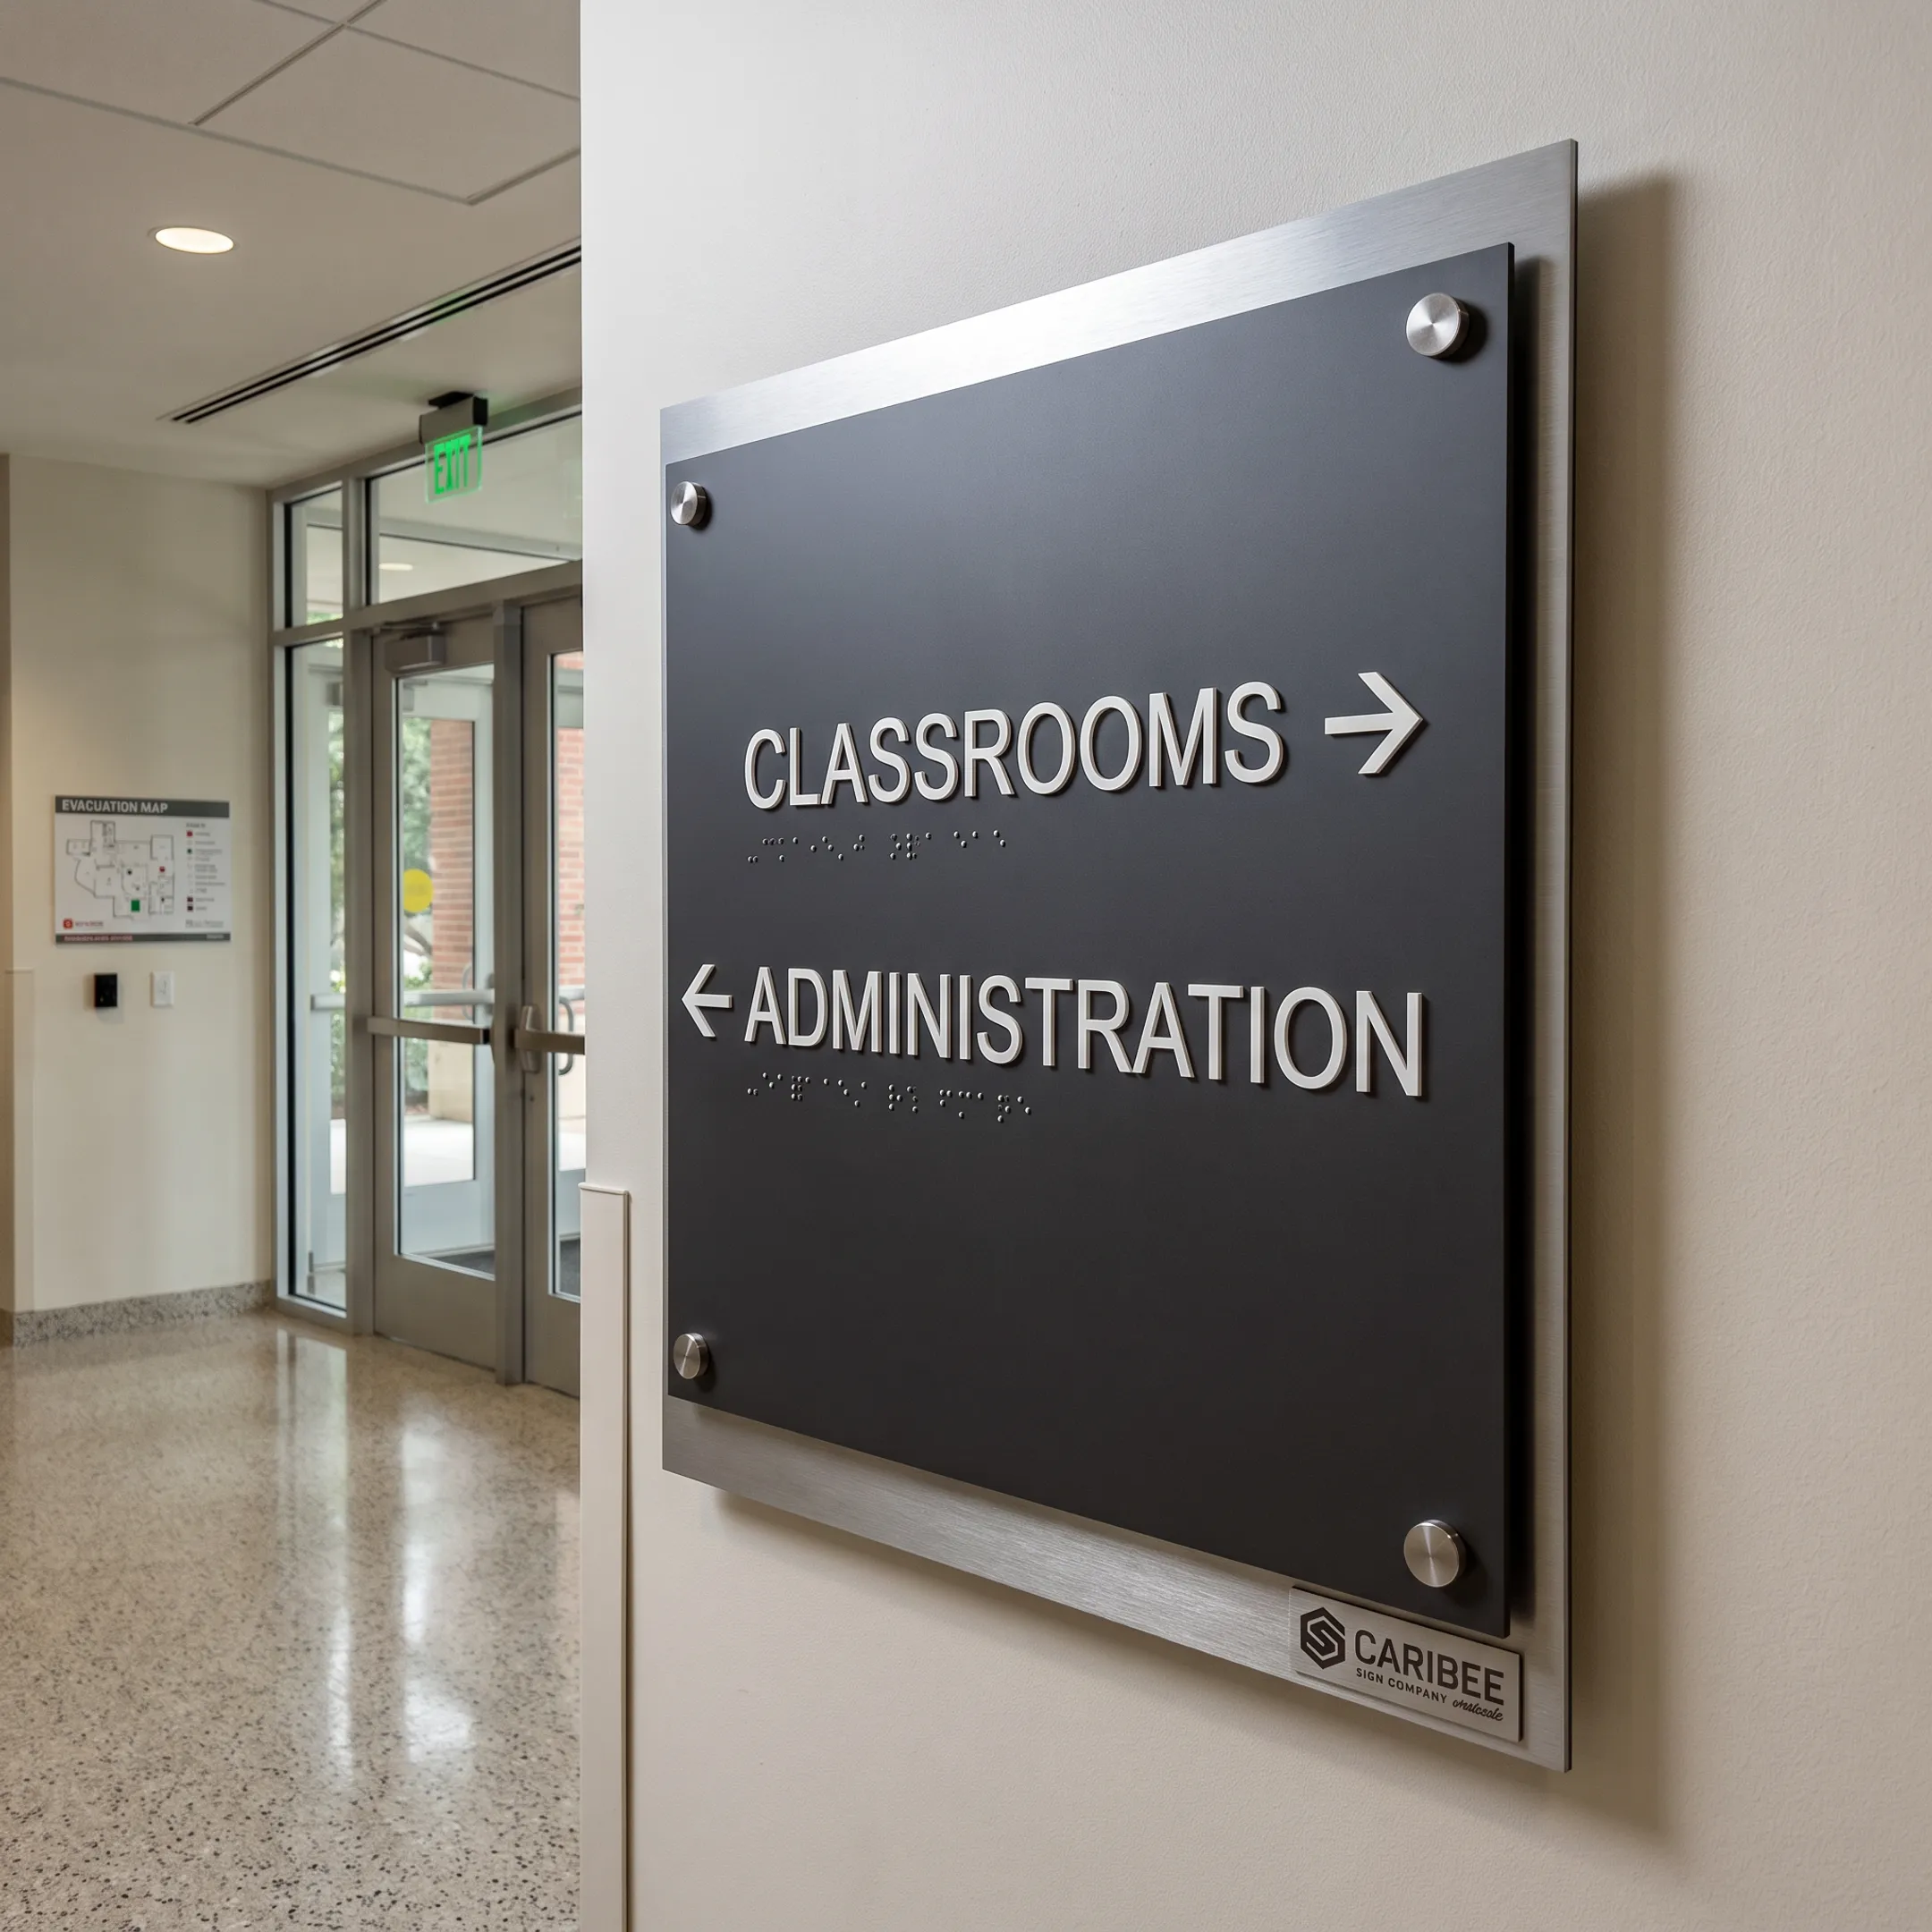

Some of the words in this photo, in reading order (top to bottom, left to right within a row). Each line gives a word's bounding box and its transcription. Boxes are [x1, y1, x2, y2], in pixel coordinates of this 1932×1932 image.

[434, 434, 471, 495] EXIT
[743, 681, 1284, 810] CLASSROOMS
[62, 799, 139, 813] EVACUATION
[140, 801, 169, 814] MAP
[744, 965, 1423, 1097] ADMINISTRATION
[1354, 1629, 1504, 1706] CARIBEE
[1356, 1666, 1384, 1685] SIGN
[1387, 1677, 1447, 1704] COMPANY
